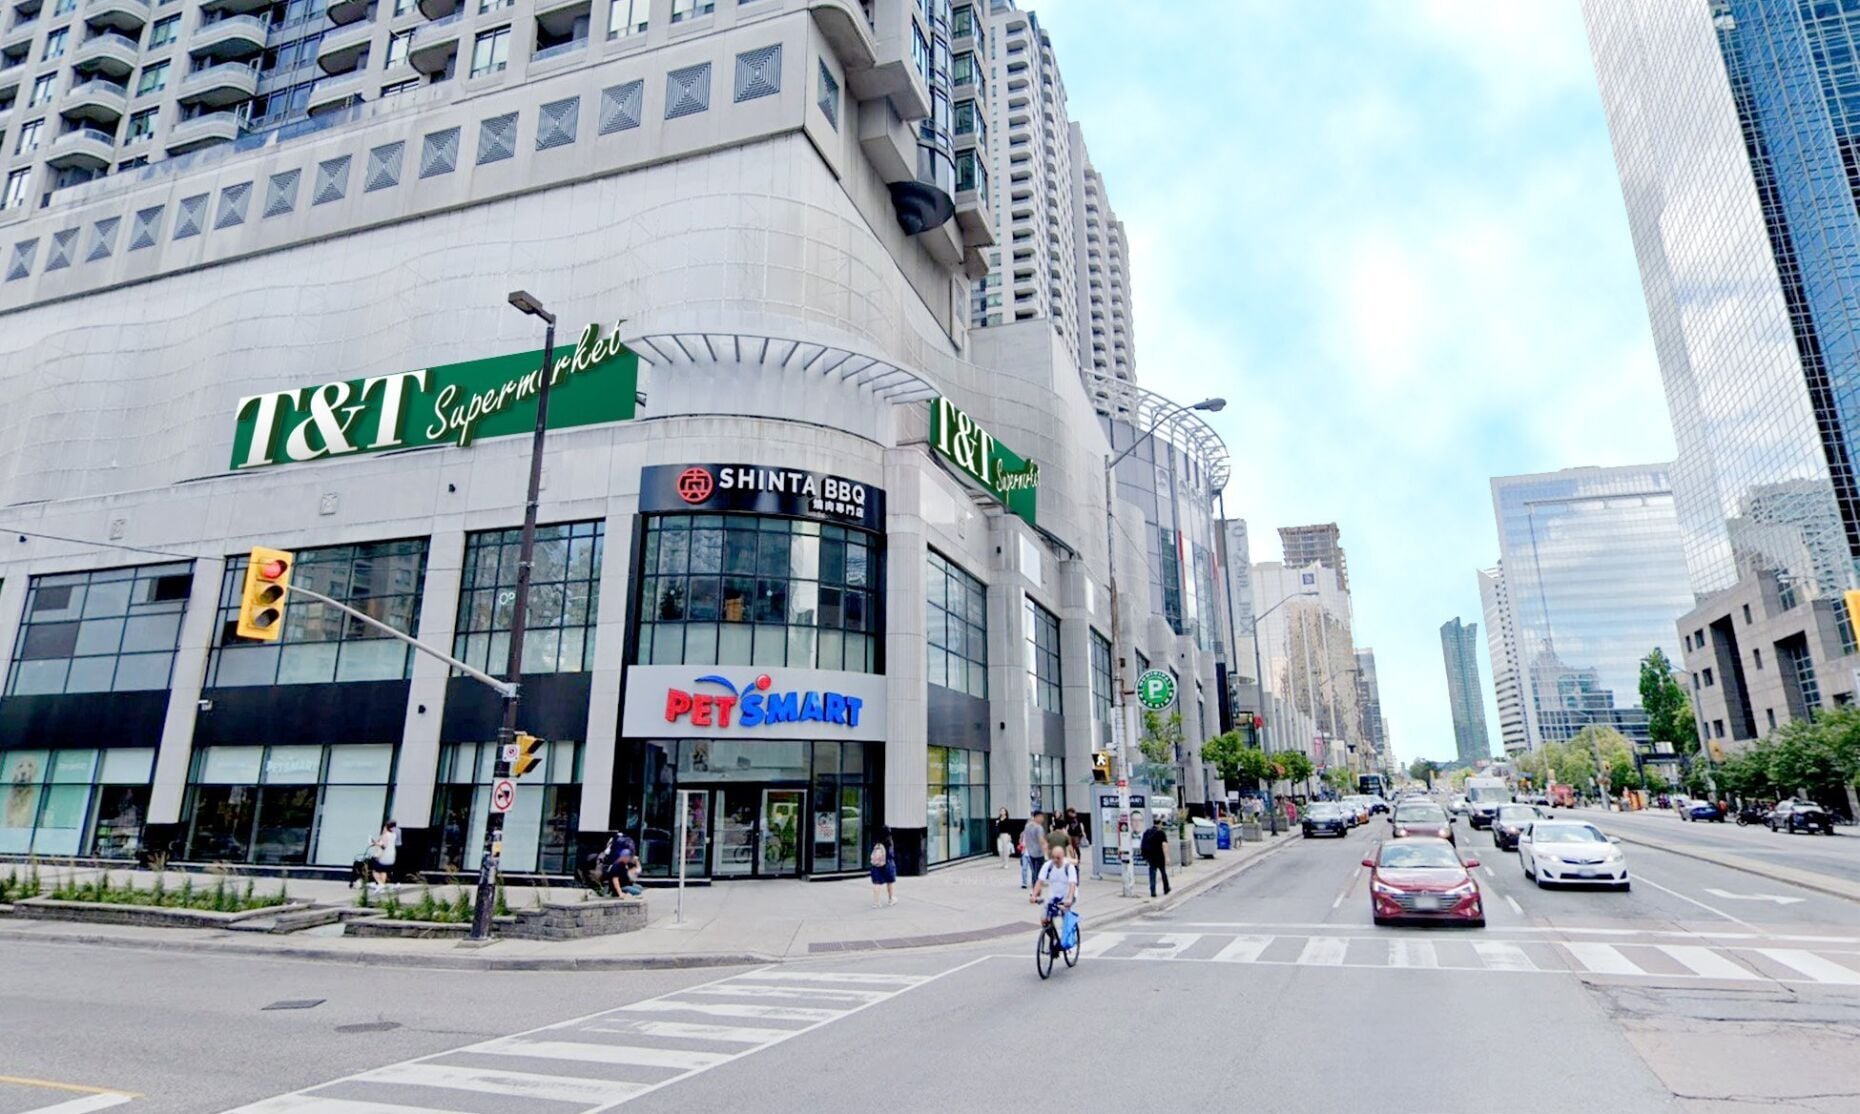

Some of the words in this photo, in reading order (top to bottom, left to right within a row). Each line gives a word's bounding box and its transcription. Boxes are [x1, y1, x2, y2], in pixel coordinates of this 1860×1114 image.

[234, 368, 428, 468] T&T
[425, 319, 628, 446] Supermrket
[931, 395, 995, 485] T&T
[719, 467, 817, 497] SHINTA
[824, 478, 866, 505] BBQ
[664, 685, 863, 728] PETSMART
[1148, 679, 1164, 699] P
